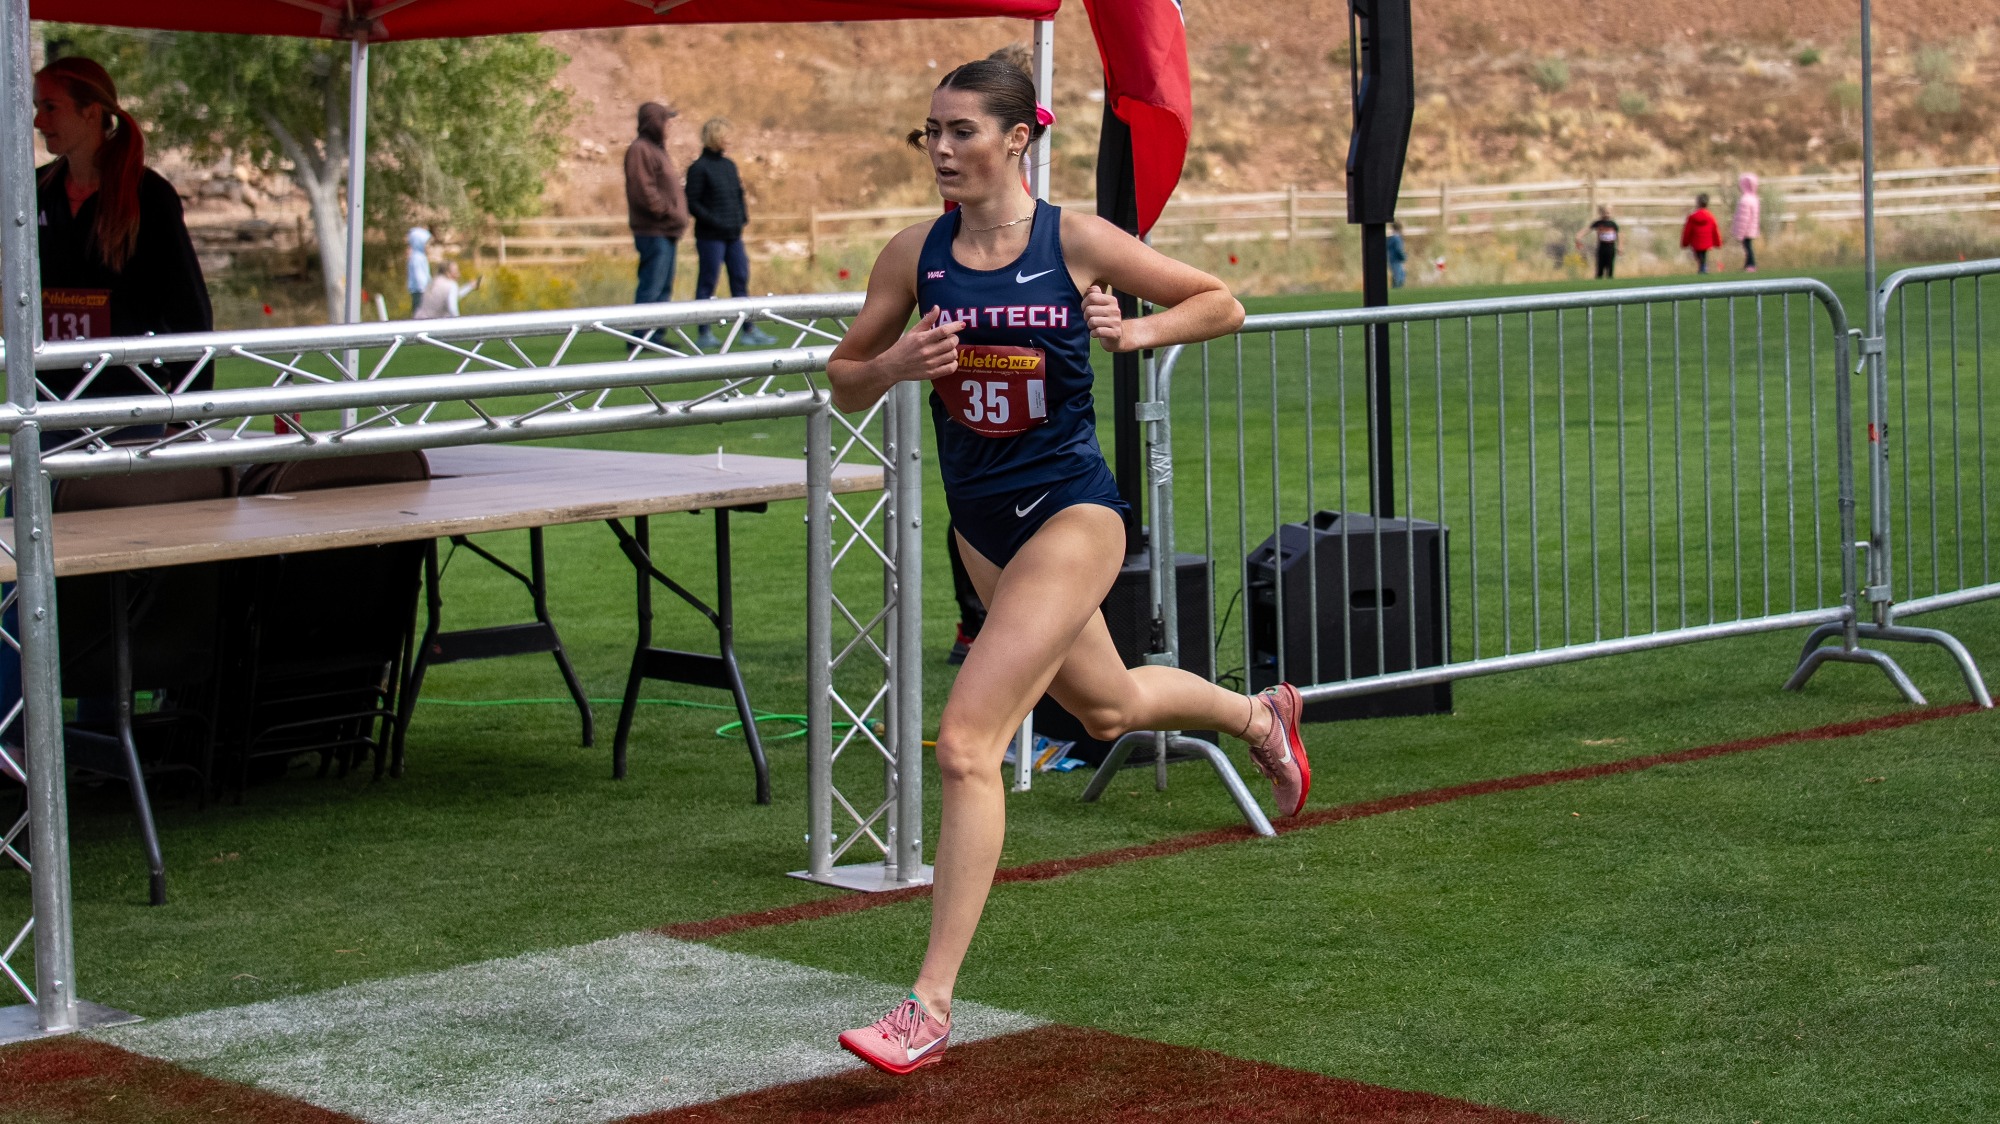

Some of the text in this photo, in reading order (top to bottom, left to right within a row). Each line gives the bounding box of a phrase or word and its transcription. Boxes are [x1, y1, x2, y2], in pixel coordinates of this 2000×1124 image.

[927, 270, 946, 279] WAC
[48, 313, 91, 340] 131
[924, 306, 1068, 328] AH TECH
[958, 348, 1036, 369] hletic NET
[961, 379, 1010, 424] 35
